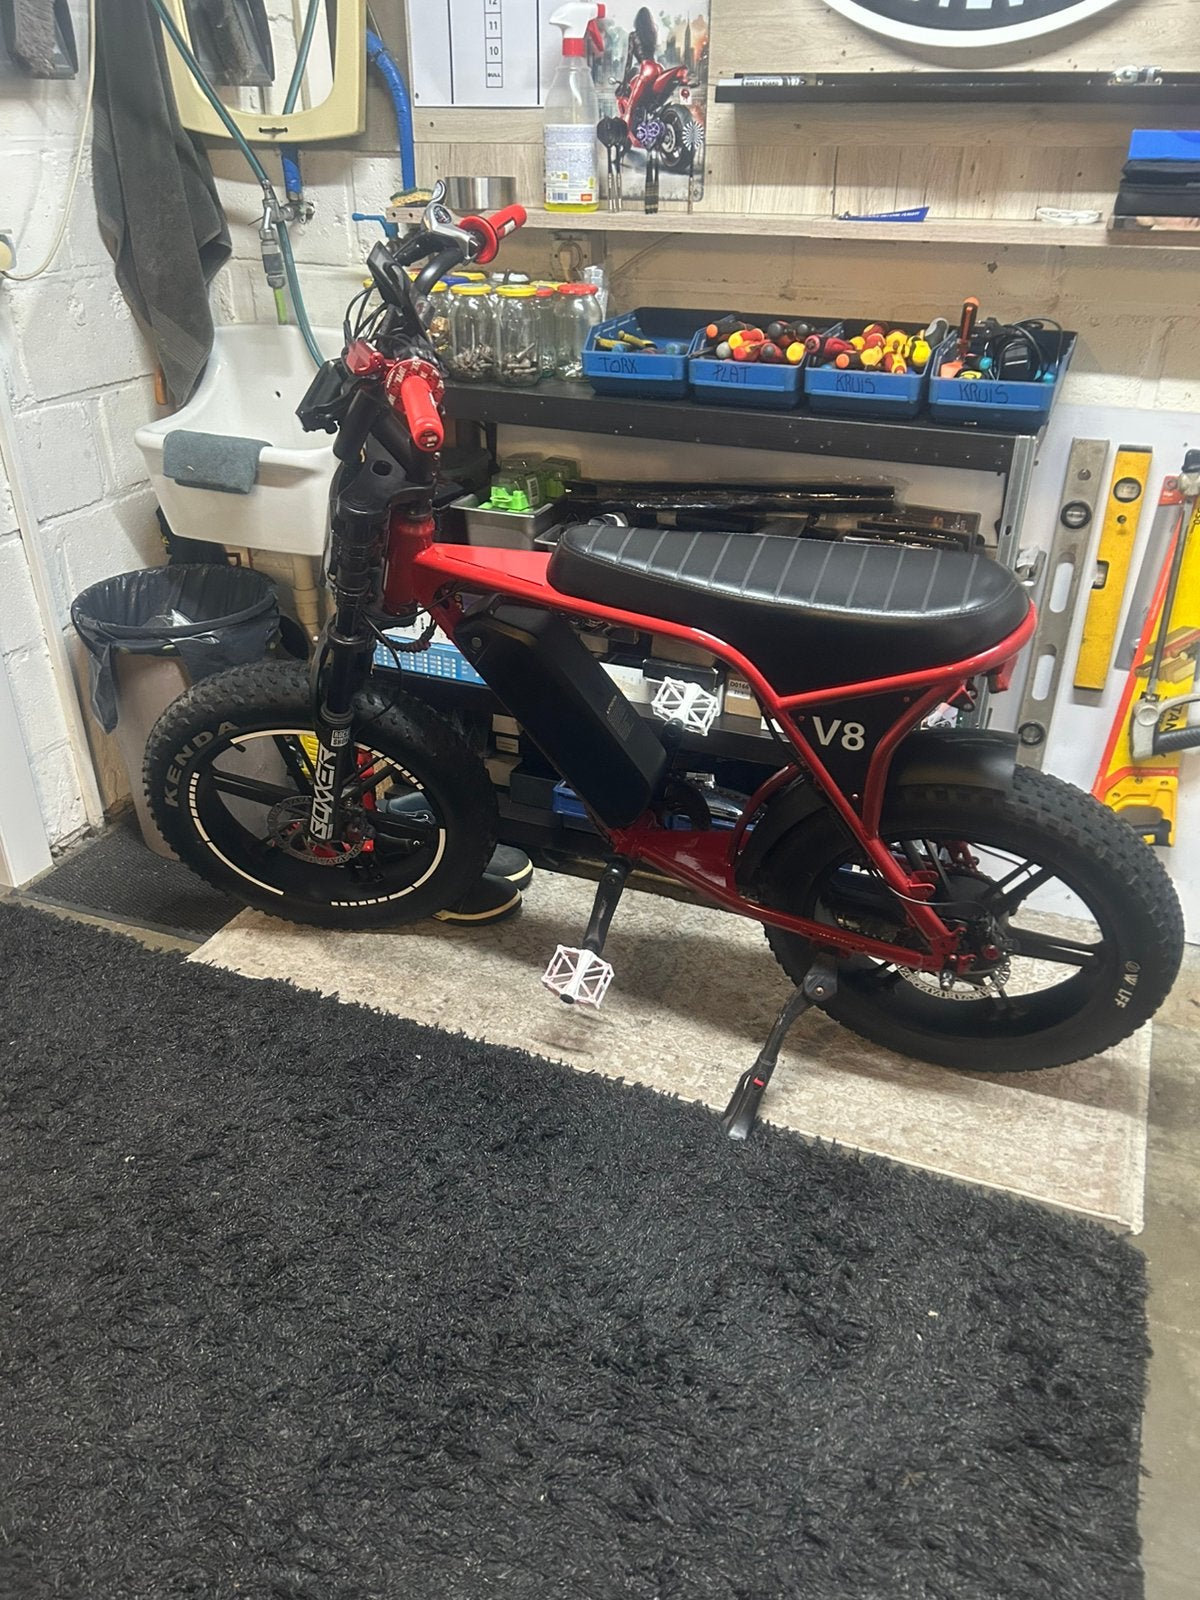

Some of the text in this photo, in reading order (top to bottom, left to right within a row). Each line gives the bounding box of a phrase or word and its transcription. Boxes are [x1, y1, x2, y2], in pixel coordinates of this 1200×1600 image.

[489, 21, 498, 30] 11
[489, 46, 499, 56] 10
[598, 356, 638, 374] TORX
[712, 364, 750, 384] PLAT
[835, 373, 876, 394] KRUIS
[958, 383, 1009, 404] KRUIS
[812, 716, 865, 751] V8
[164, 721, 239, 808] KENDA
[310, 742, 337, 840] BOXXER
